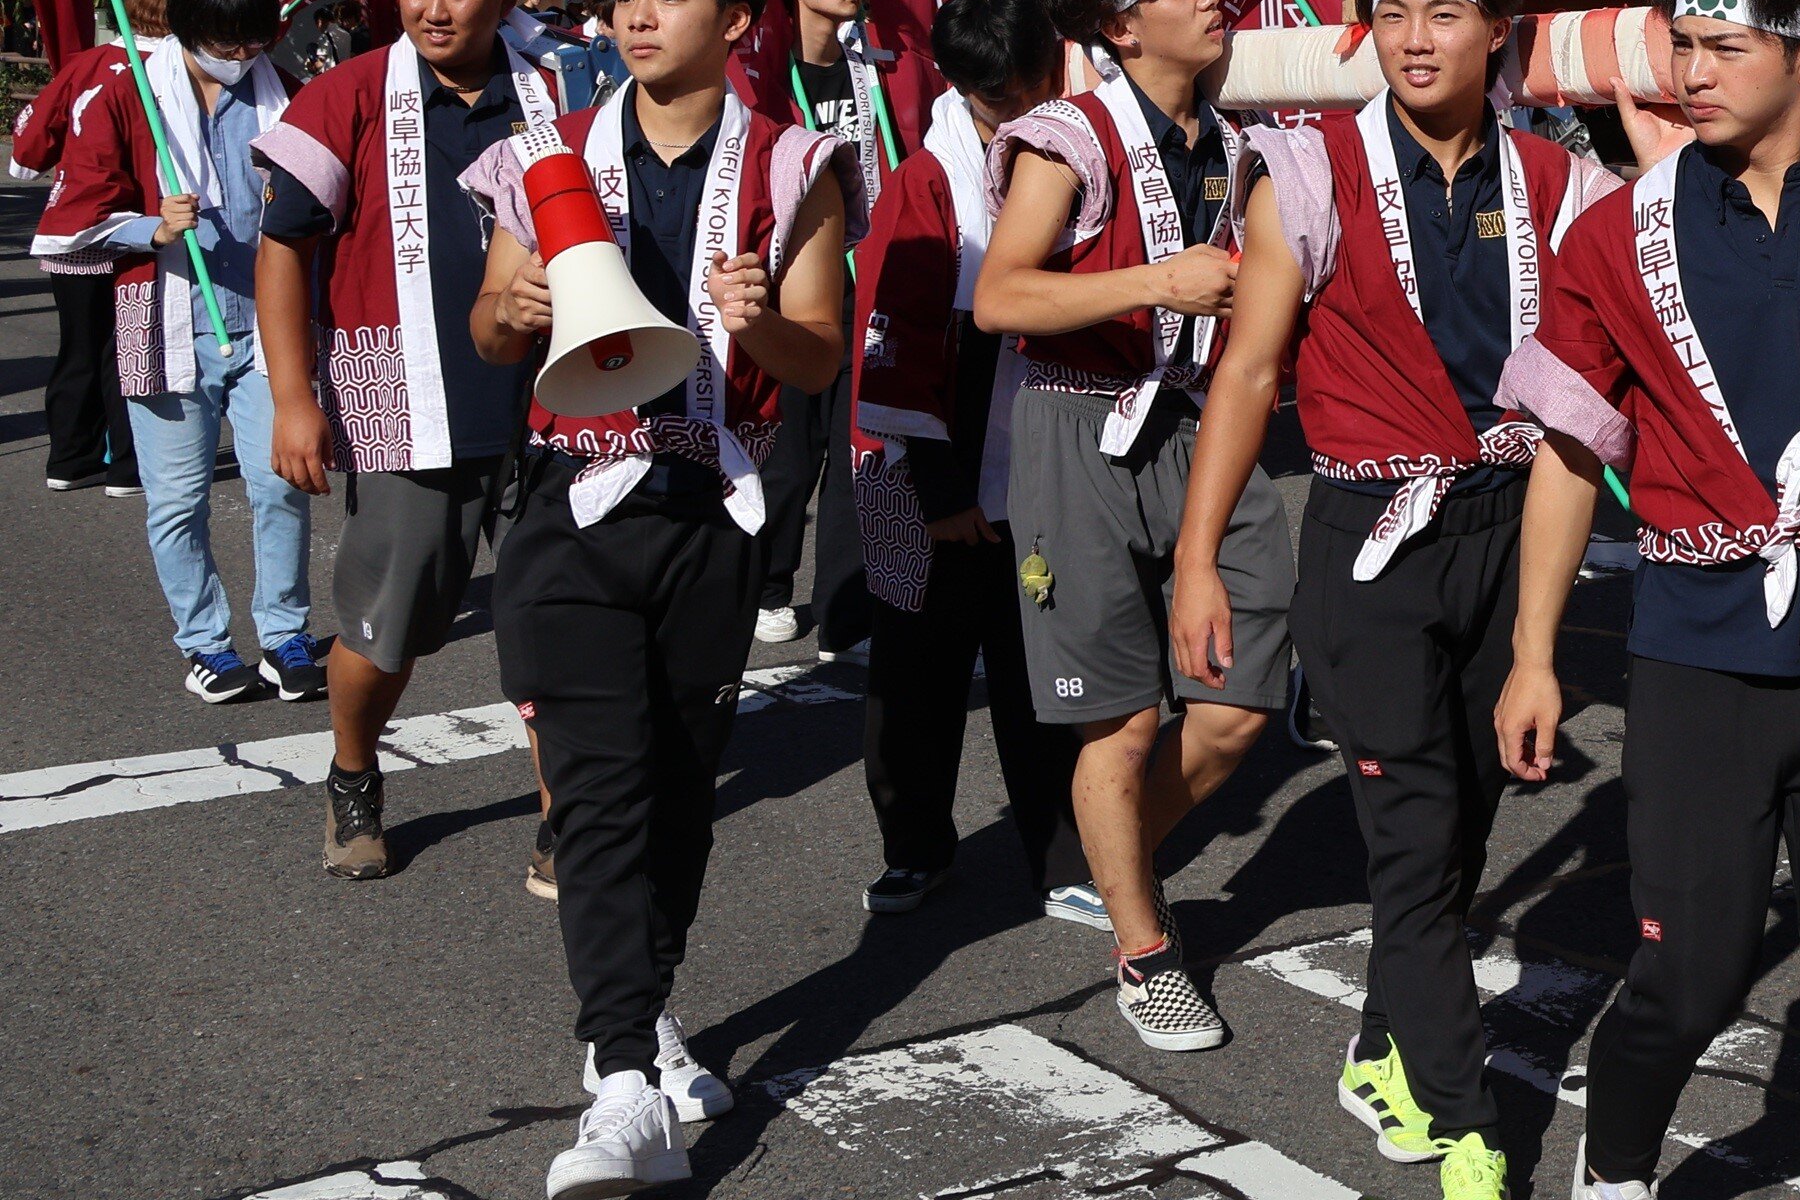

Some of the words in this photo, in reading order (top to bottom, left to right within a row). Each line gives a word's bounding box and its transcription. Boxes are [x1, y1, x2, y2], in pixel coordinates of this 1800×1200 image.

[518, 71, 540, 104] GIFU
[815, 99, 855, 128] NIKE
[718, 136, 740, 182] GIFU
[389, 87, 428, 276] 岐阜協立大学
[1515, 215, 1539, 326] KYORITSU
[1055, 677, 1084, 698] 88
